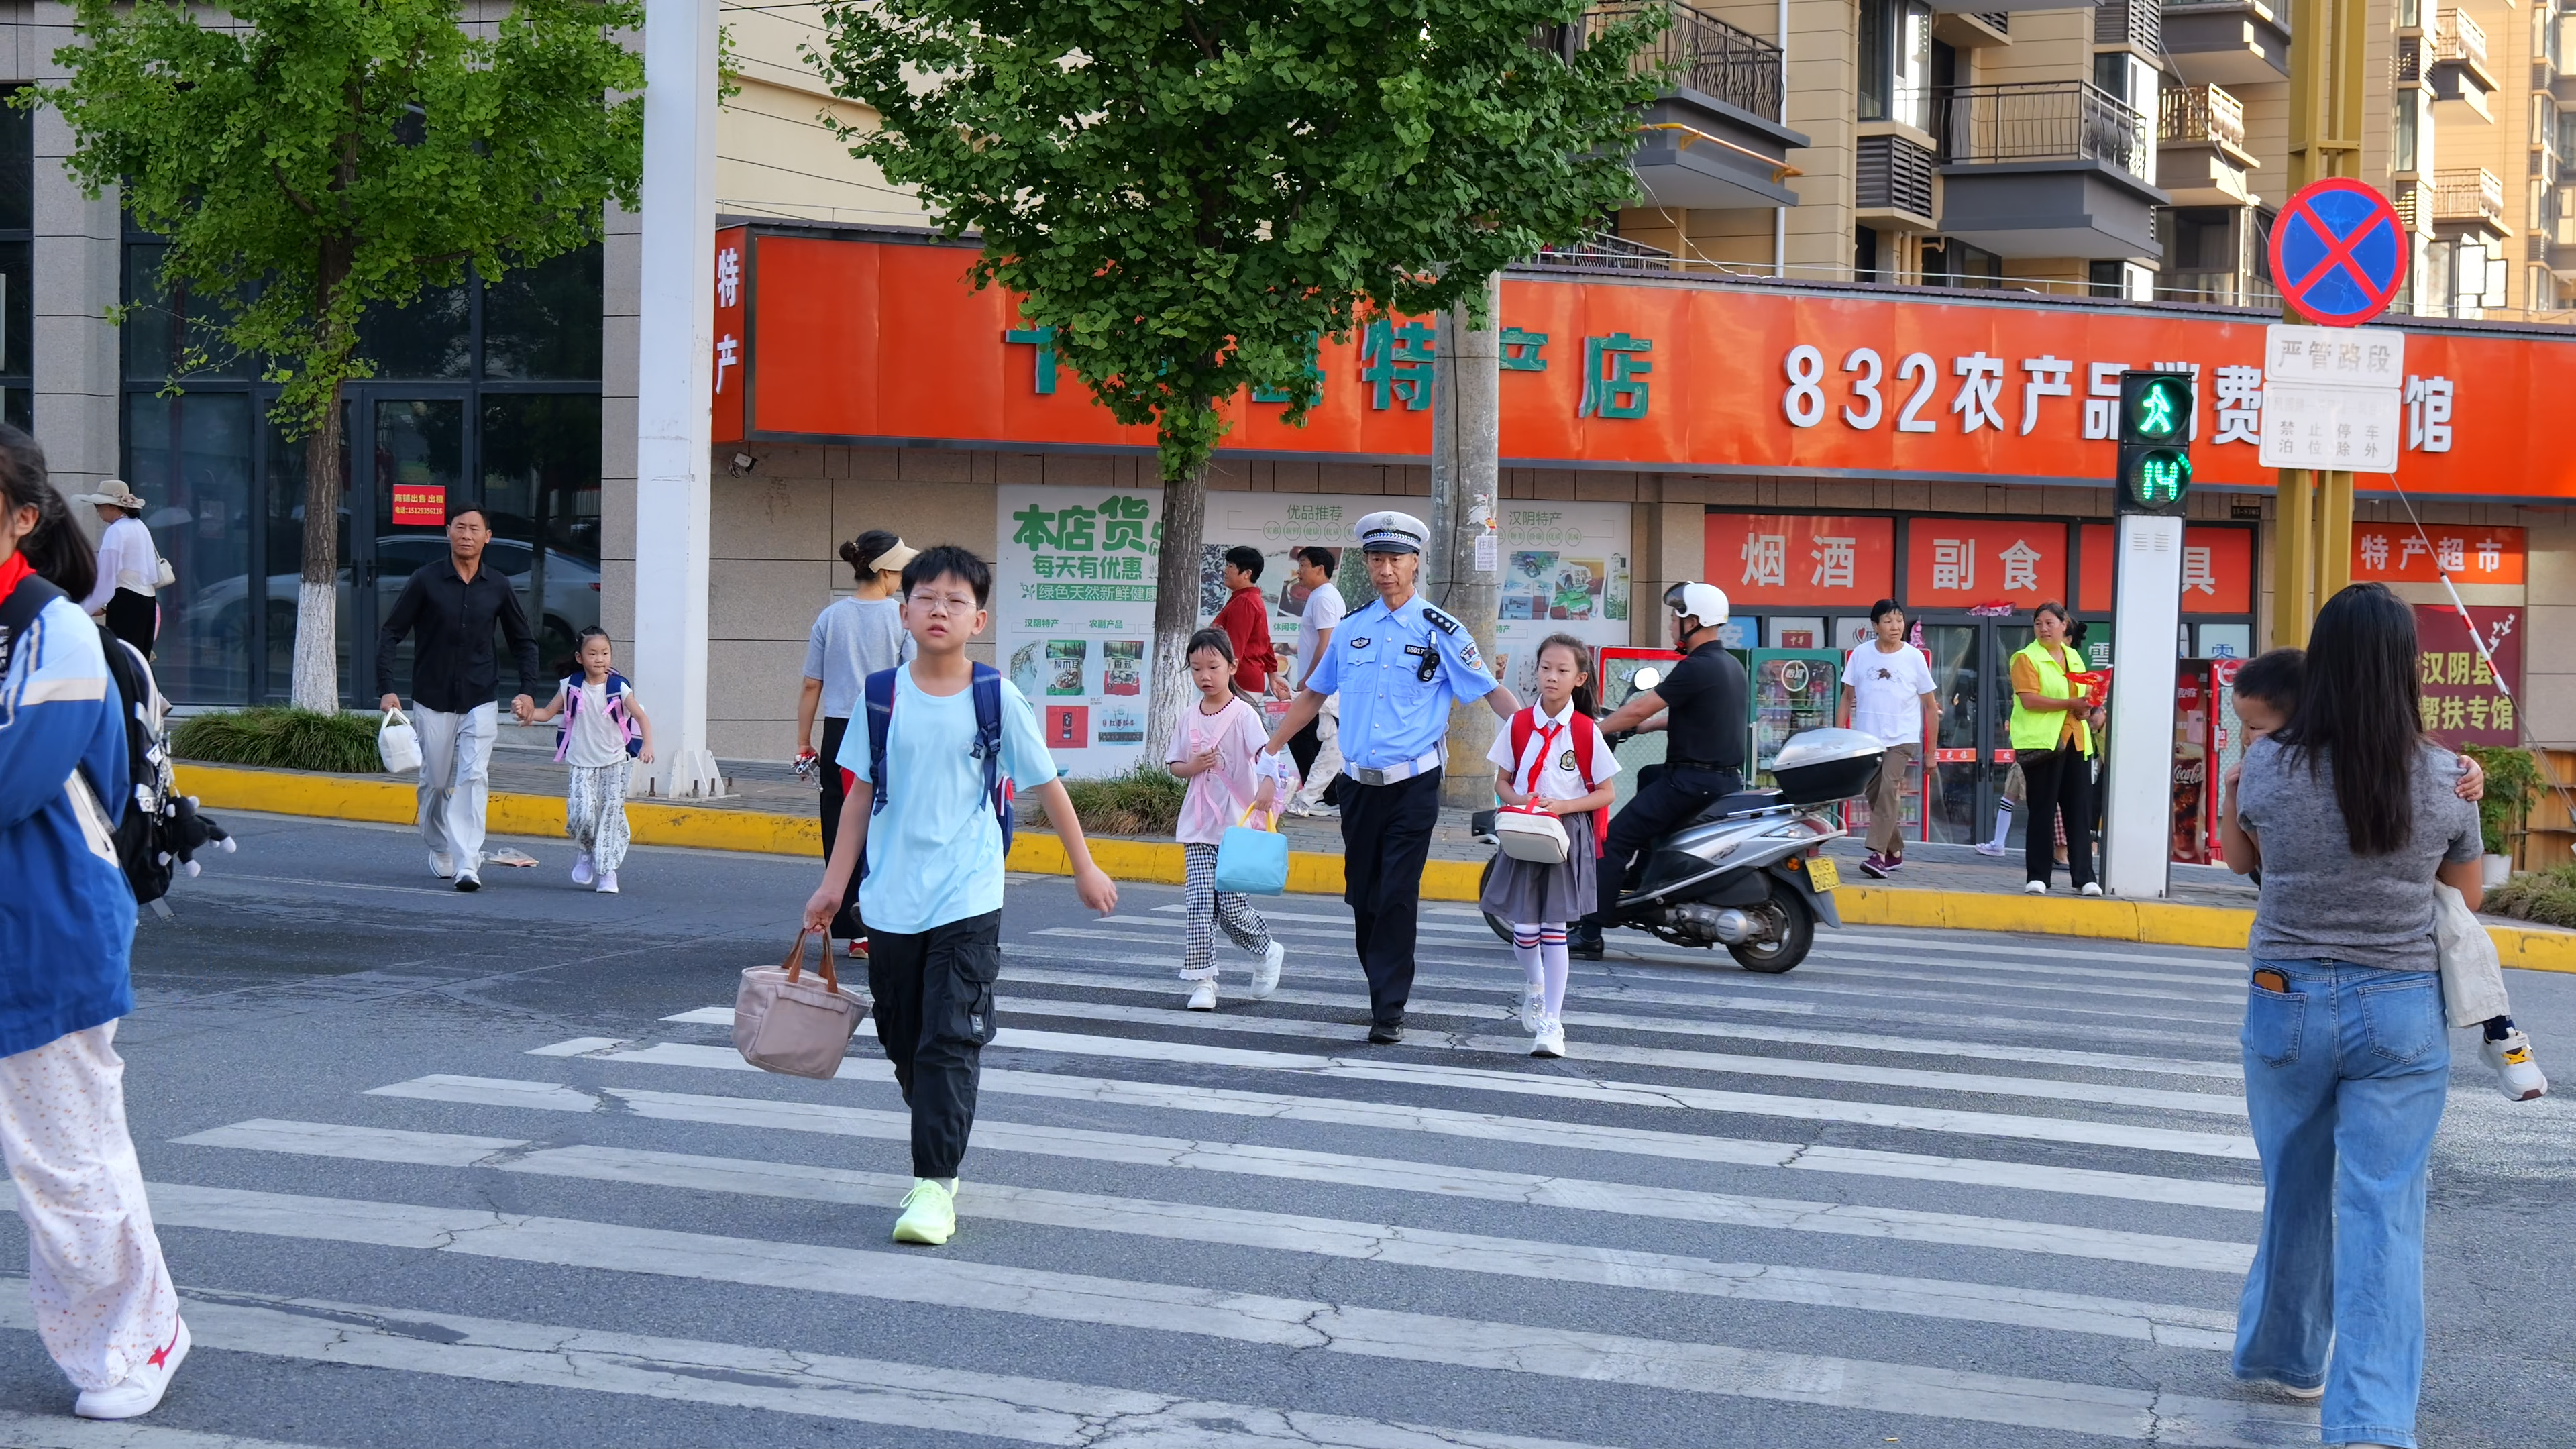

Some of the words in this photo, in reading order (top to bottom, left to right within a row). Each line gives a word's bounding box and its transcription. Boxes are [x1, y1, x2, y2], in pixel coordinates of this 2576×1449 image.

[716, 247, 739, 394] 特产
[2278, 340, 2390, 373] 严管路段
[2279, 421, 2379, 439] 禁止停车
[2279, 439, 2378, 458] 泊位除外
[2143, 460, 2178, 500] 14
[1013, 495, 1164, 551] 本店货
[1287, 504, 1342, 521] 优品推荐
[1509, 511, 1562, 526] 汉阴特产
[1032, 554, 1142, 580] 每天有优惠
[1741, 533, 1856, 588] 烟酒
[1933, 539, 2041, 592] 副食
[2361, 534, 2502, 572] 特产超市
[1024, 619, 1059, 628] 汉阴特产
[1089, 619, 1123, 629] 农副产品
[2422, 651, 2494, 685] 汉阴县
[2419, 695, 2513, 730] 帮扶专馆
